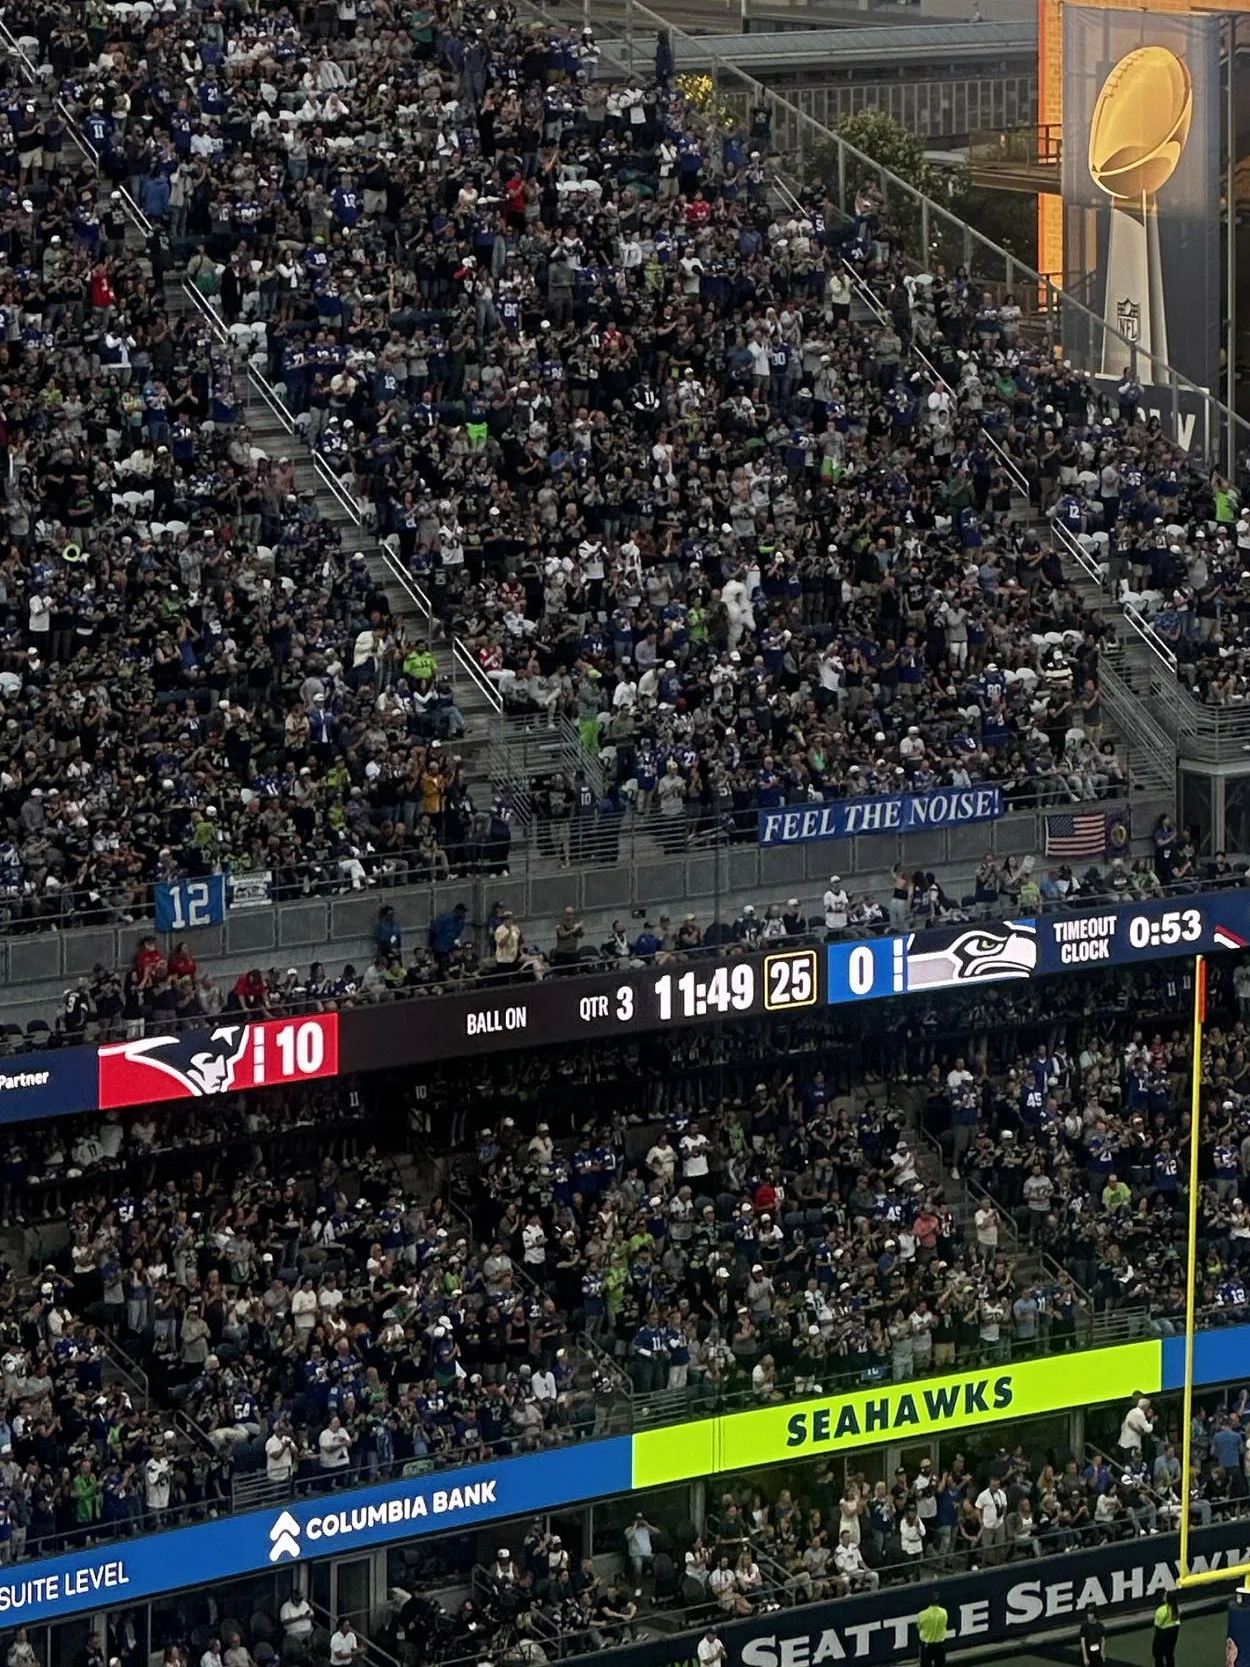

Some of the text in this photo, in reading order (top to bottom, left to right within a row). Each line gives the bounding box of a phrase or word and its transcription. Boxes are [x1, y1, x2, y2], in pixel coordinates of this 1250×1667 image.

[94, 124, 105, 139] 11
[1117, 316, 1138, 342] NFL
[644, 391, 656, 405] 11
[1069, 505, 1081, 519] 12
[763, 789, 1000, 842] FEEL THE NOISE!
[169, 882, 210, 929] 12
[1053, 915, 1117, 943] TIMEOUT
[1129, 909, 1202, 948] 0:53
[849, 946, 874, 996] 0
[1061, 938, 1110, 965] CLOCK
[467, 964, 754, 1036] BALL ON QTR 3 11:49
[770, 958, 811, 1005] 25
[277, 1021, 324, 1076] 10
[0, 1071, 49, 1089] Partner
[1231, 1288, 1246, 1303] 12
[652, 1335, 662, 1352] 11
[786, 1376, 1013, 1447] SEAHAWKS
[306, 1480, 497, 1541] COLUMBIA BANK
[0, 1561, 129, 1612] SUITE LEVEL
[741, 1599, 989, 1667] SEATTE
